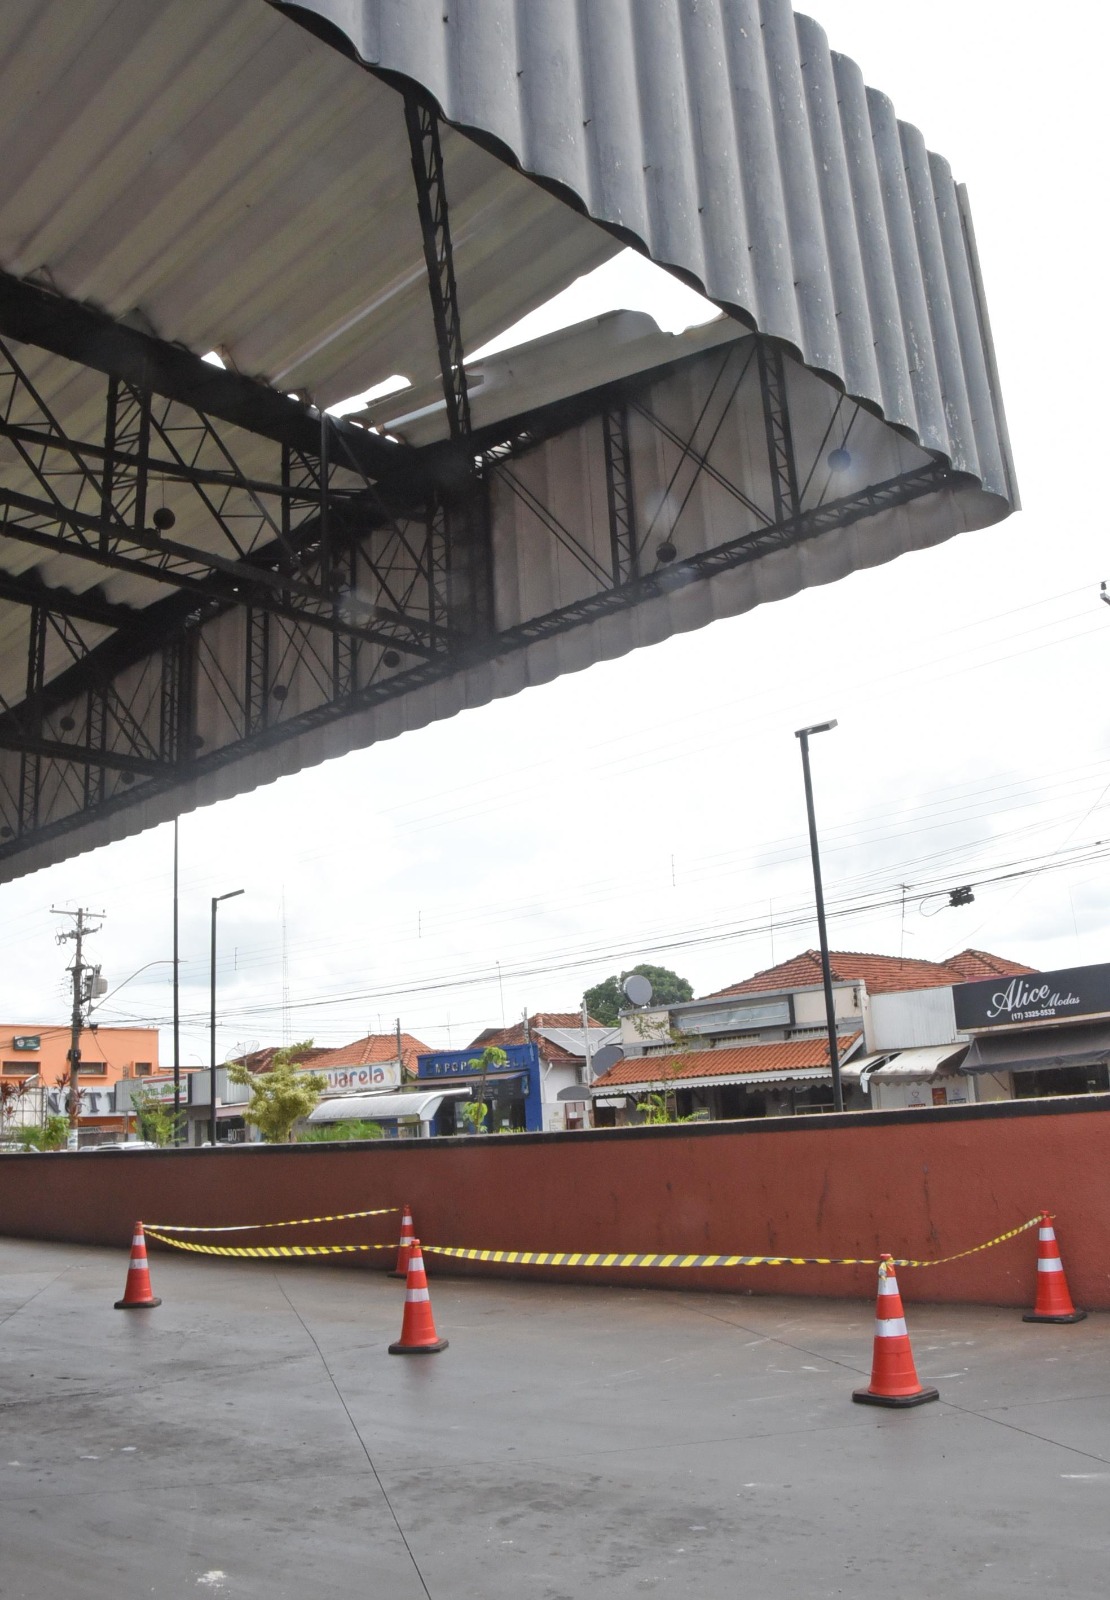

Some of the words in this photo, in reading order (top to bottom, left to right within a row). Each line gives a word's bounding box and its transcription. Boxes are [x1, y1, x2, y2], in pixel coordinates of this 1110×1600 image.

[986, 978, 1050, 1018] Alice
[1041, 993, 1080, 1008] Modas
[1011, 1012, 1024, 1021] (17)
[1024, 1008, 1056, 1019] 3325-5532
[311, 1065, 385, 1092] uarela
